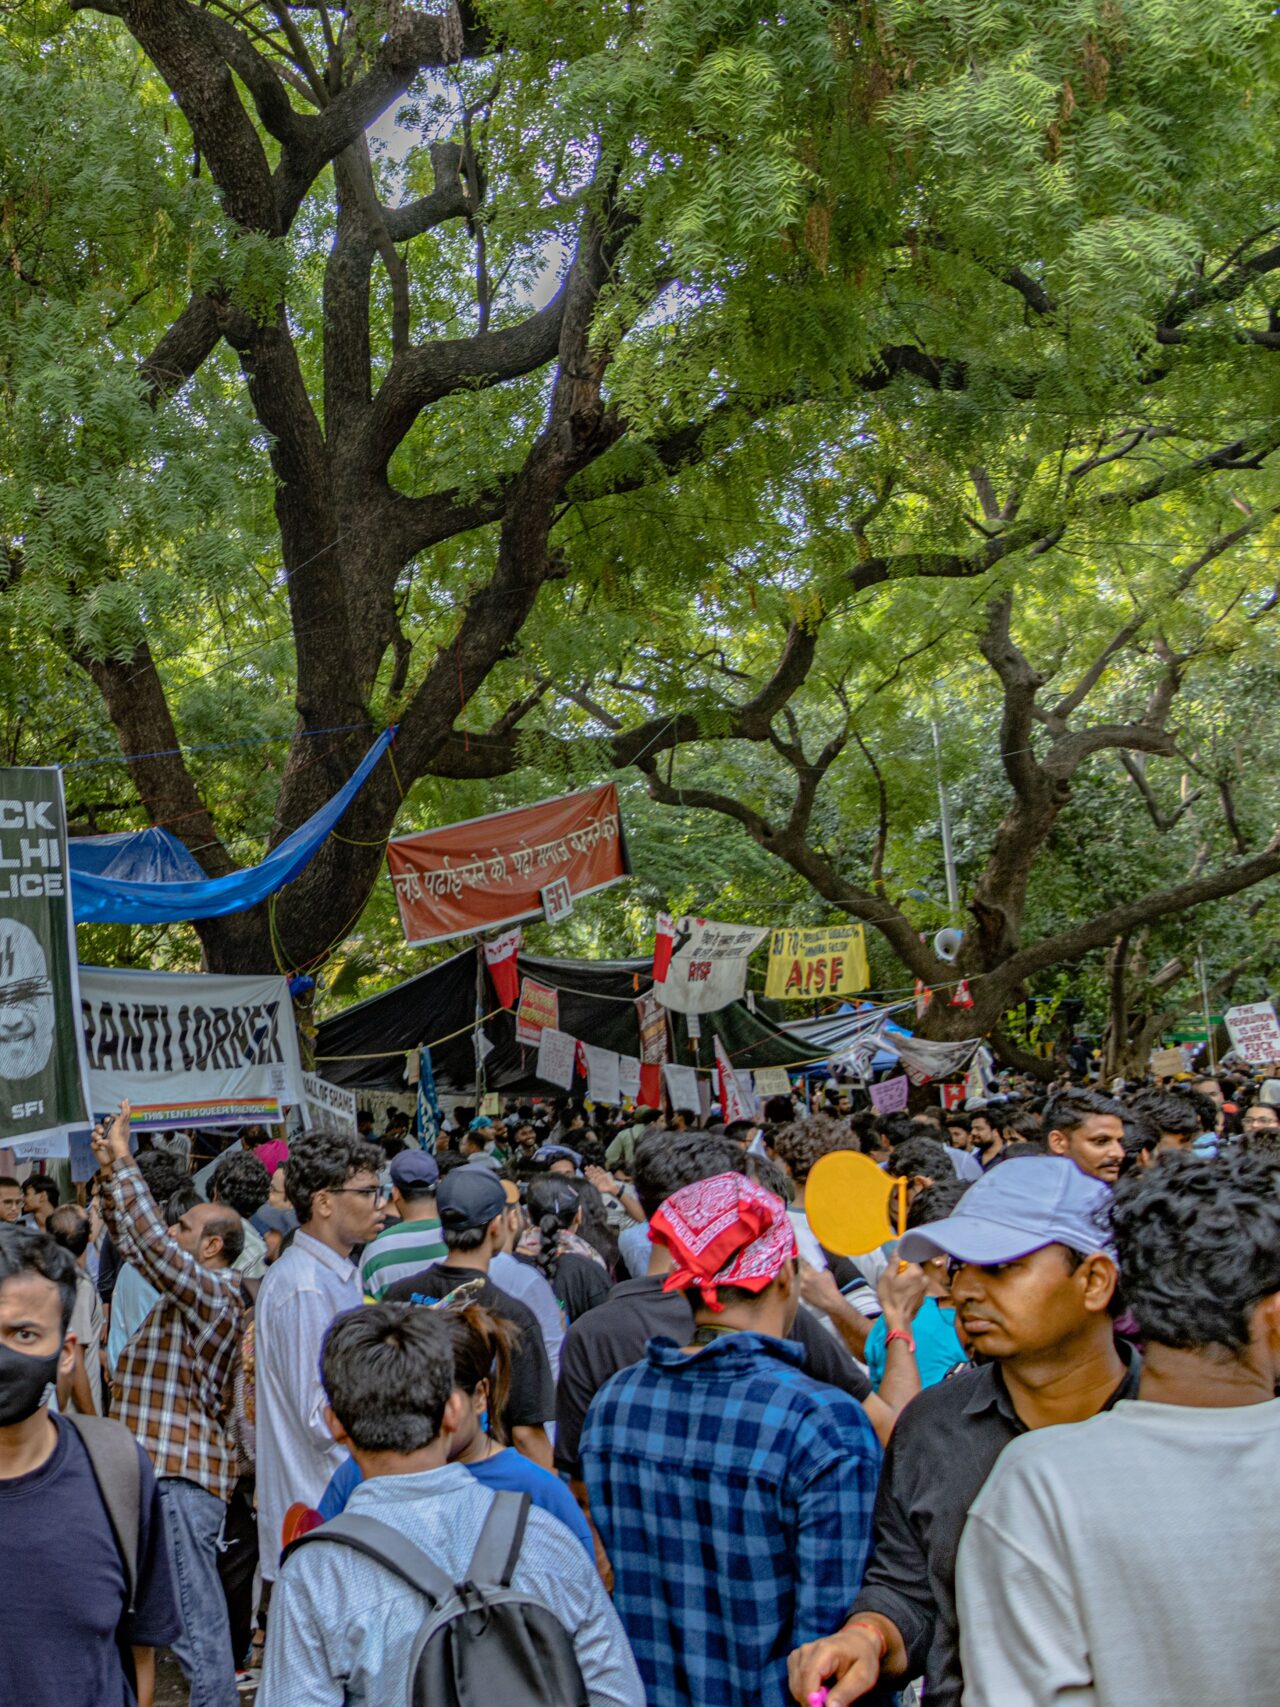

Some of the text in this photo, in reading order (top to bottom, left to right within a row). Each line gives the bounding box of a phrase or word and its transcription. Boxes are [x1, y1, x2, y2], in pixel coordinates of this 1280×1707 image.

[534, 839, 572, 867] समाज
[545, 881, 571, 916] SFI
[785, 956, 843, 995] AISF
[178, 1001, 284, 1072] CORNER
[1245, 1041, 1275, 1053] FUCK
[11, 1100, 44, 1120] SFI
[166, 1110, 189, 1119] TENT
